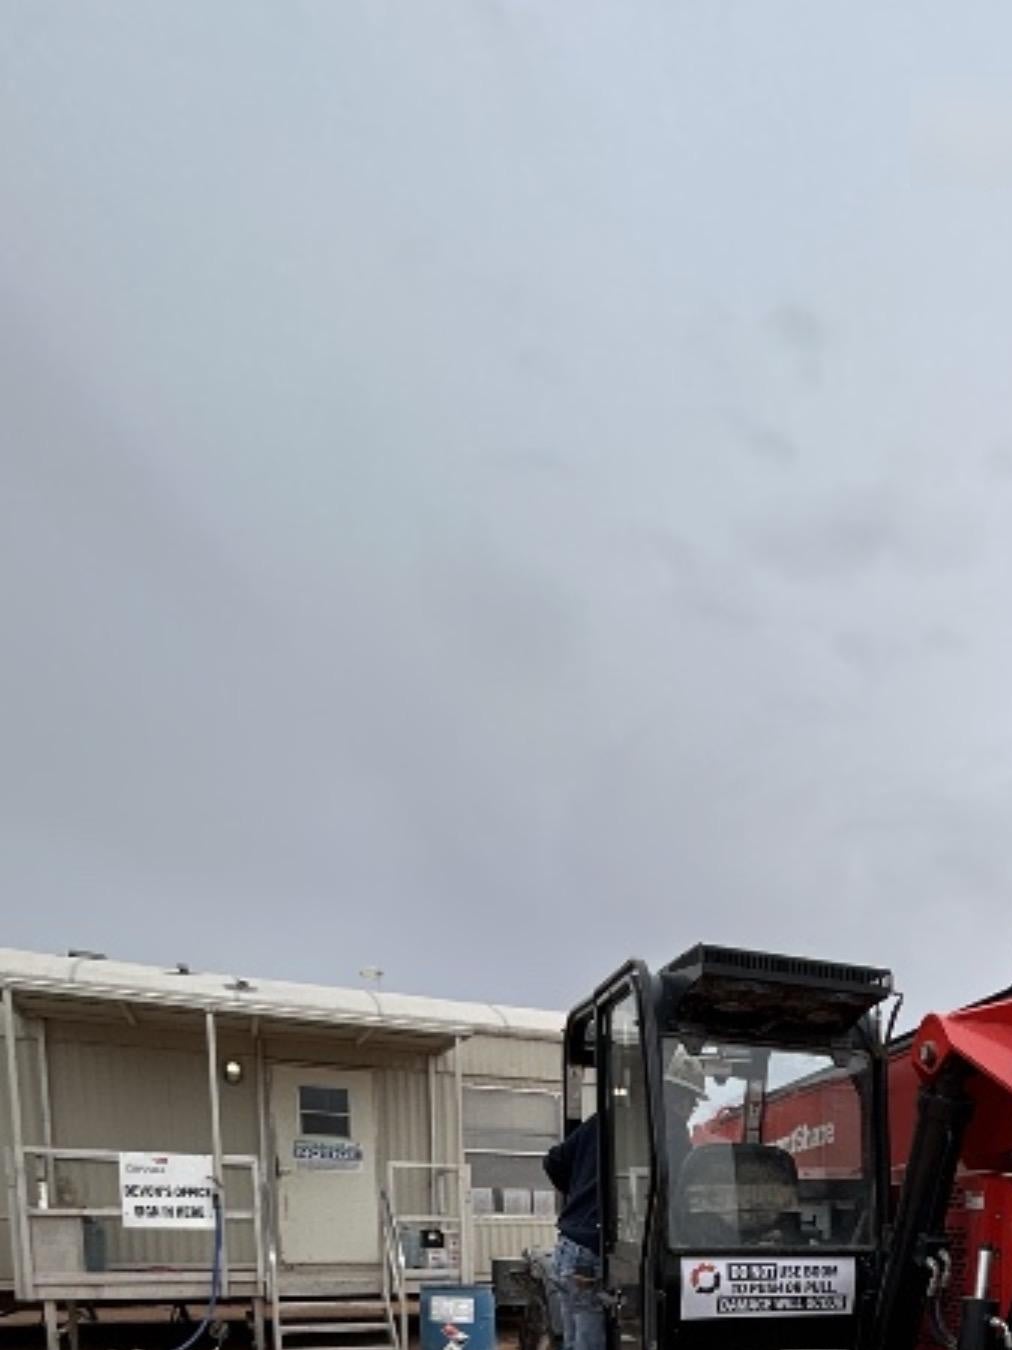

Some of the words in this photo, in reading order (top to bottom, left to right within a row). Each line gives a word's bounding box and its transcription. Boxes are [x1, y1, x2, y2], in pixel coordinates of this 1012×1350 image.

[731, 1265, 748, 1279] DO
[780, 1265, 802, 1278] USE
[731, 1283, 748, 1294] TO
